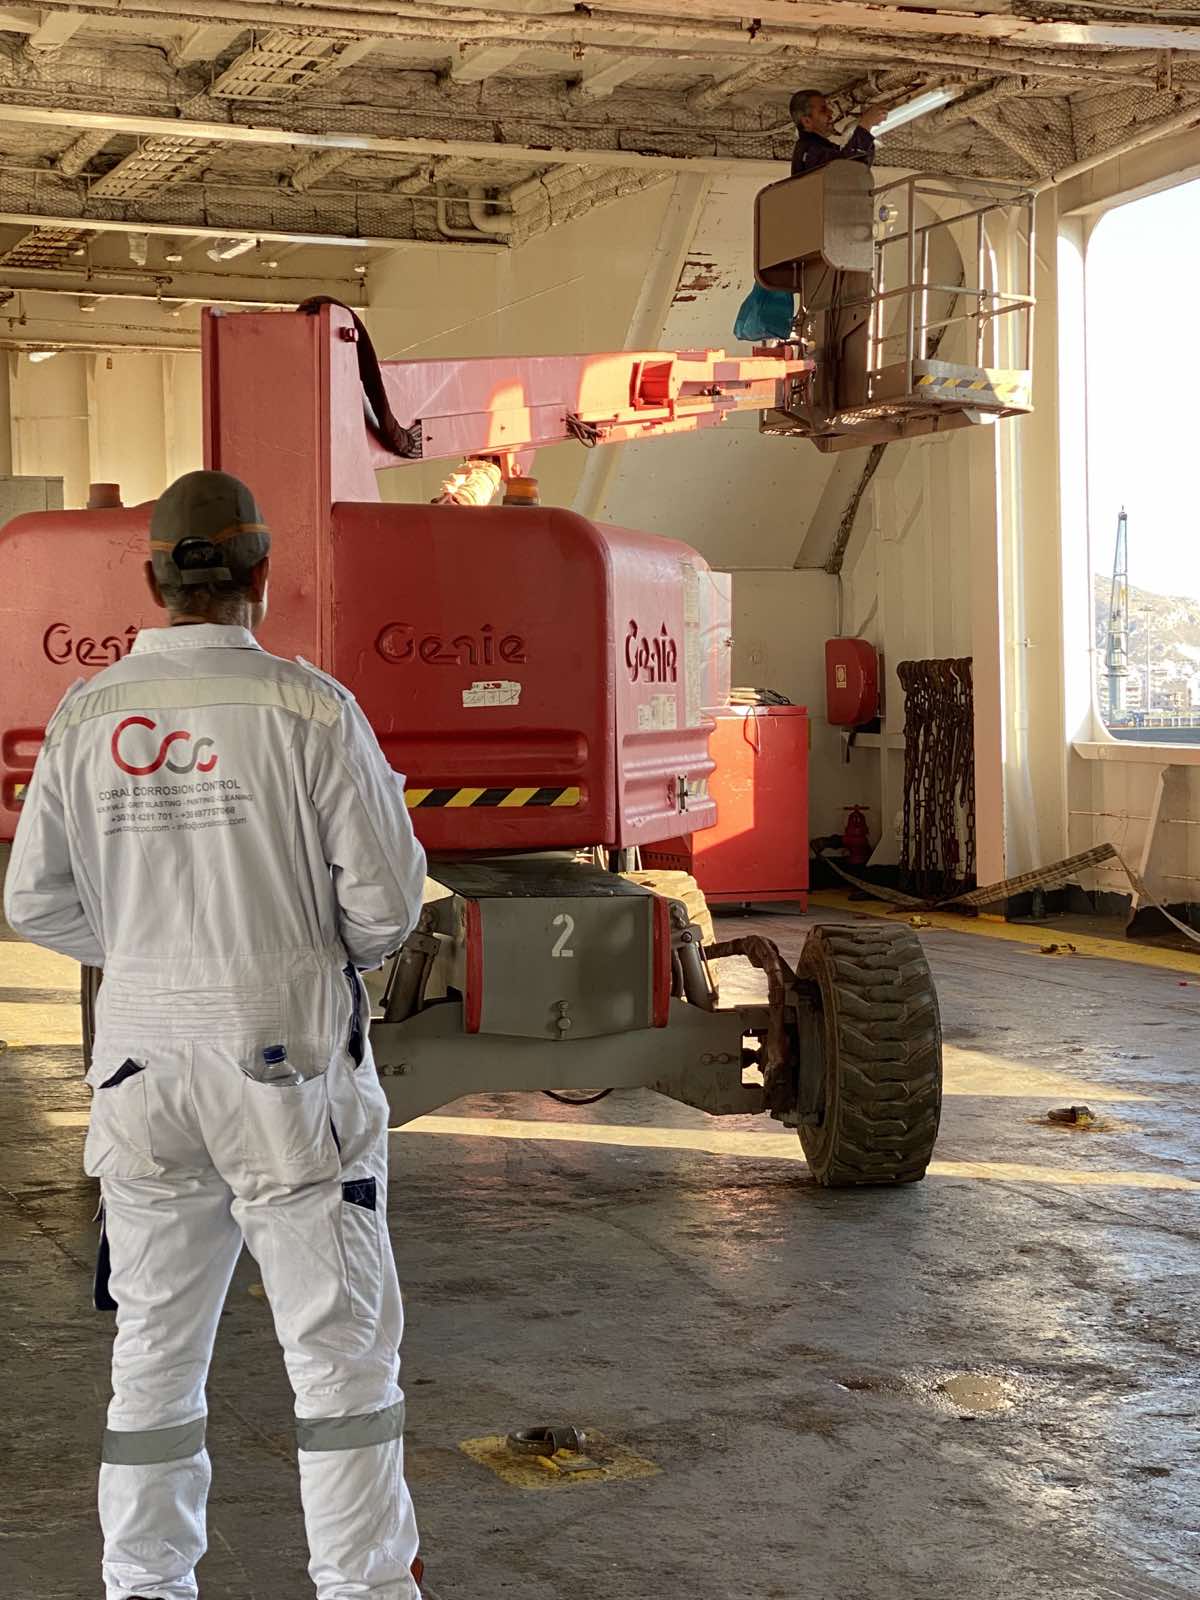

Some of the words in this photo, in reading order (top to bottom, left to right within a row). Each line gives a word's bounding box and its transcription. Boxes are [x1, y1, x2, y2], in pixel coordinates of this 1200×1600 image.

[43, 622, 138, 667] Geni
[374, 621, 527, 666] Genie
[99, 786, 131, 801] CORAL
[133, 783, 194, 797] CORROSION
[196, 779, 241, 792] CONTROL
[552, 913, 575, 957] 2
